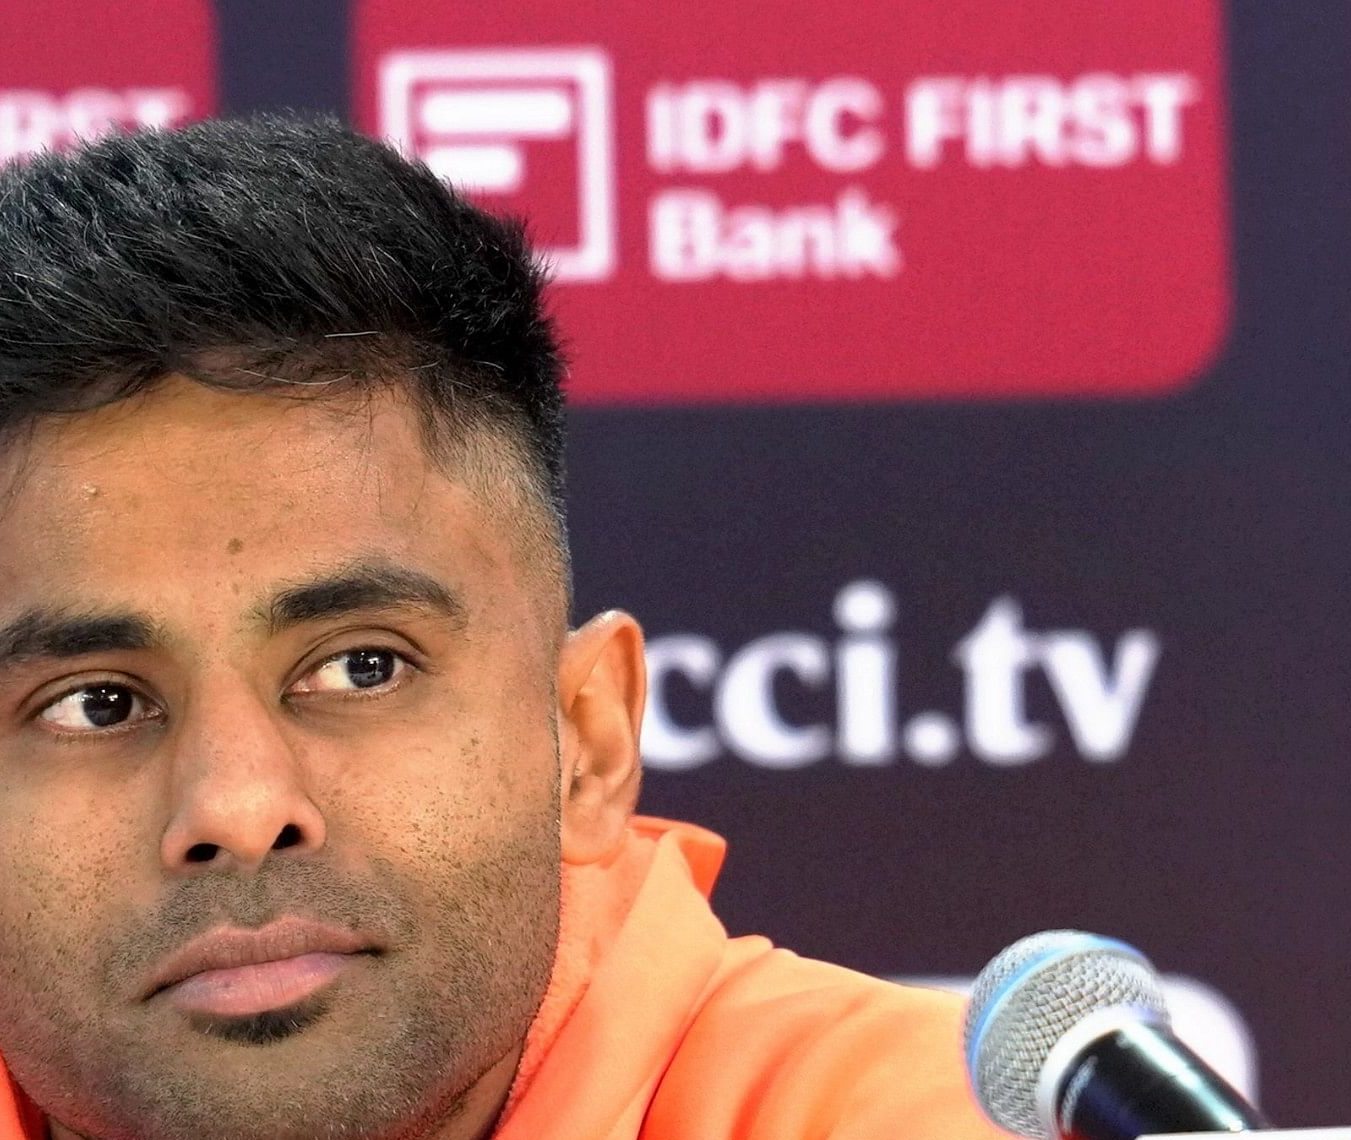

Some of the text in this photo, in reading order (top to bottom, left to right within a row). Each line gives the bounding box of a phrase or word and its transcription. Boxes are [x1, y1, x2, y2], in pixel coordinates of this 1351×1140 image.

[648, 72, 1196, 173] IDFC FIRST
[649, 188, 901, 281] Bank
